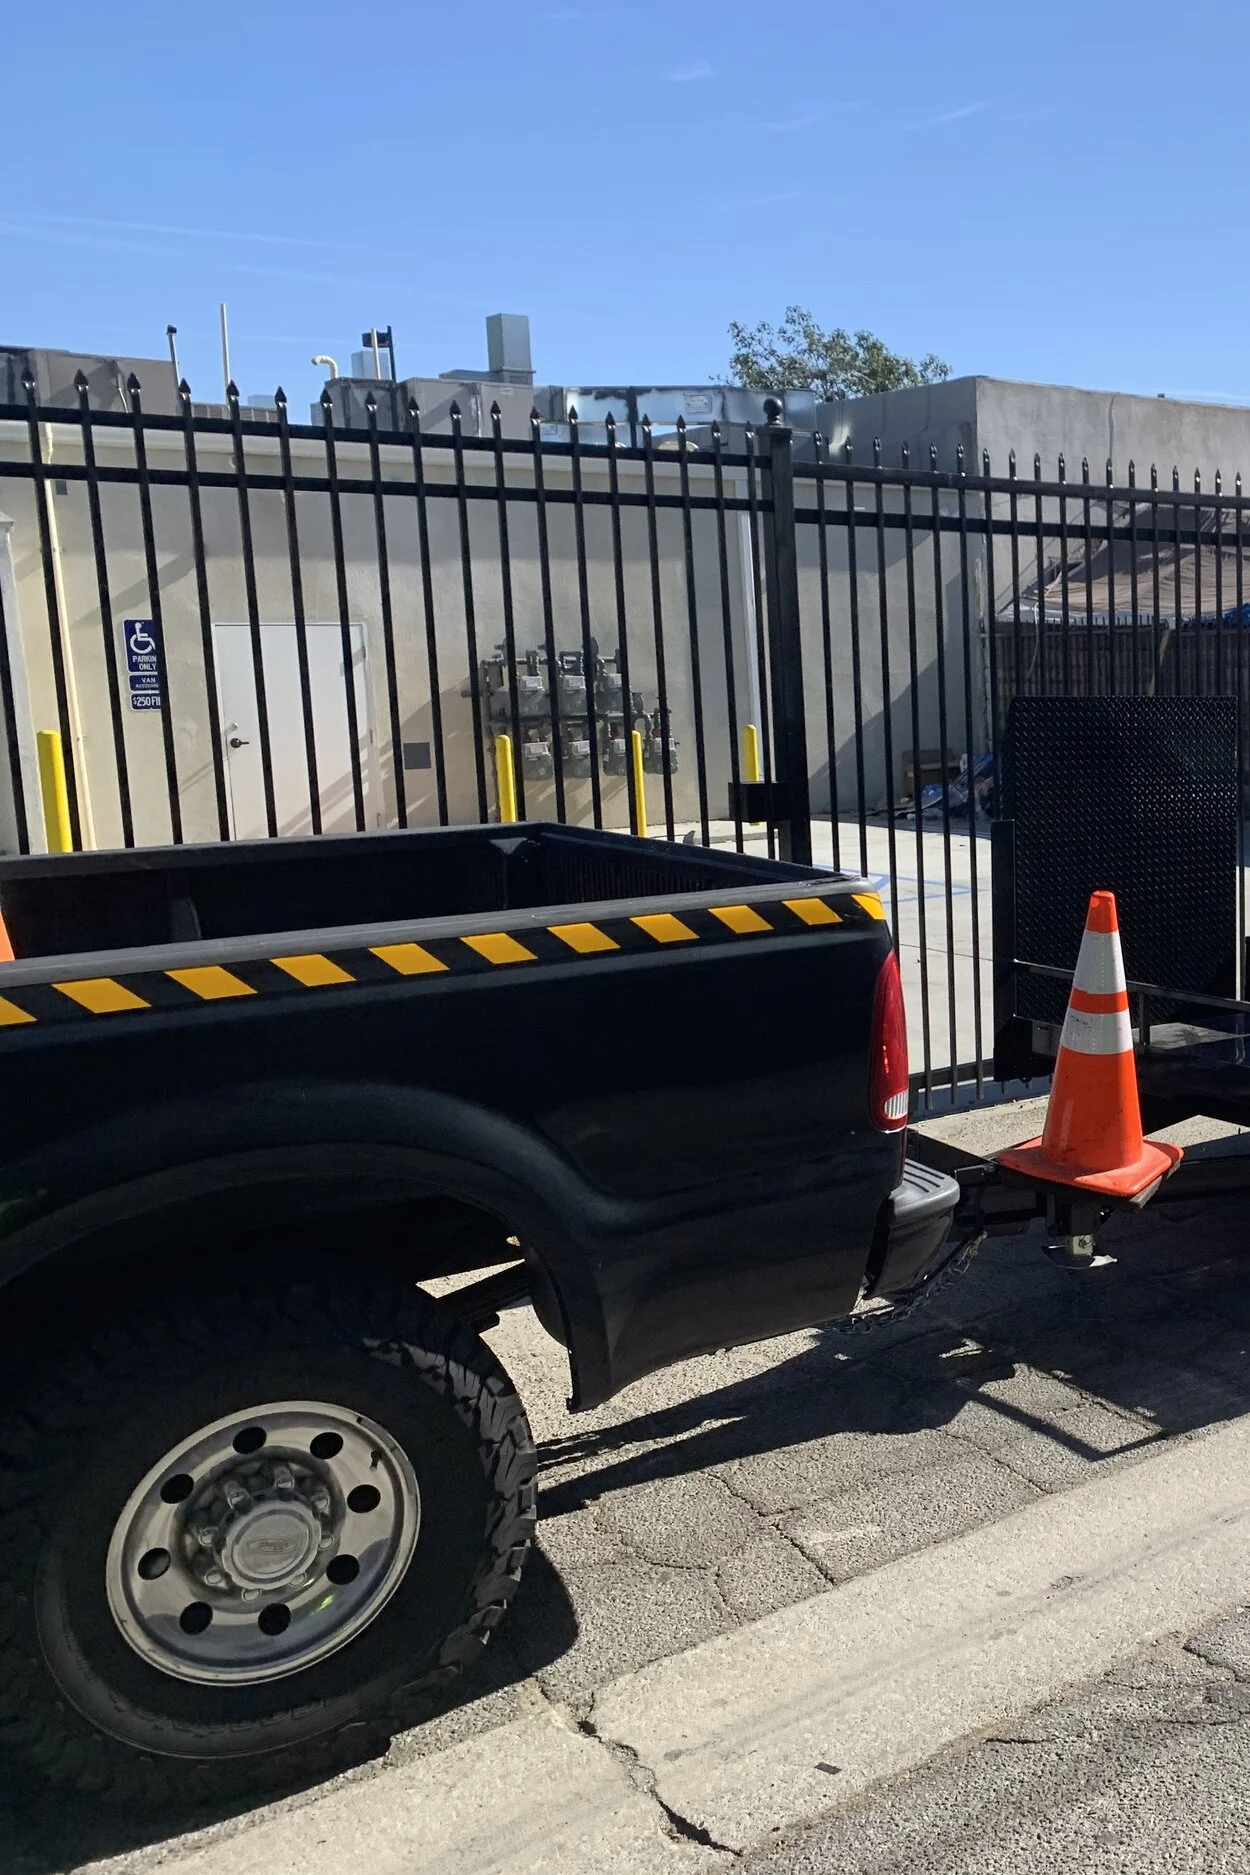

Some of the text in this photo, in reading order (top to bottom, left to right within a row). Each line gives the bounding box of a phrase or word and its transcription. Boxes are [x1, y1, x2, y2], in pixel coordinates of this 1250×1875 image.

[132, 655, 157, 663] PARKIN
[138, 663, 156, 671] ONLY
[132, 696, 151, 707] $250
